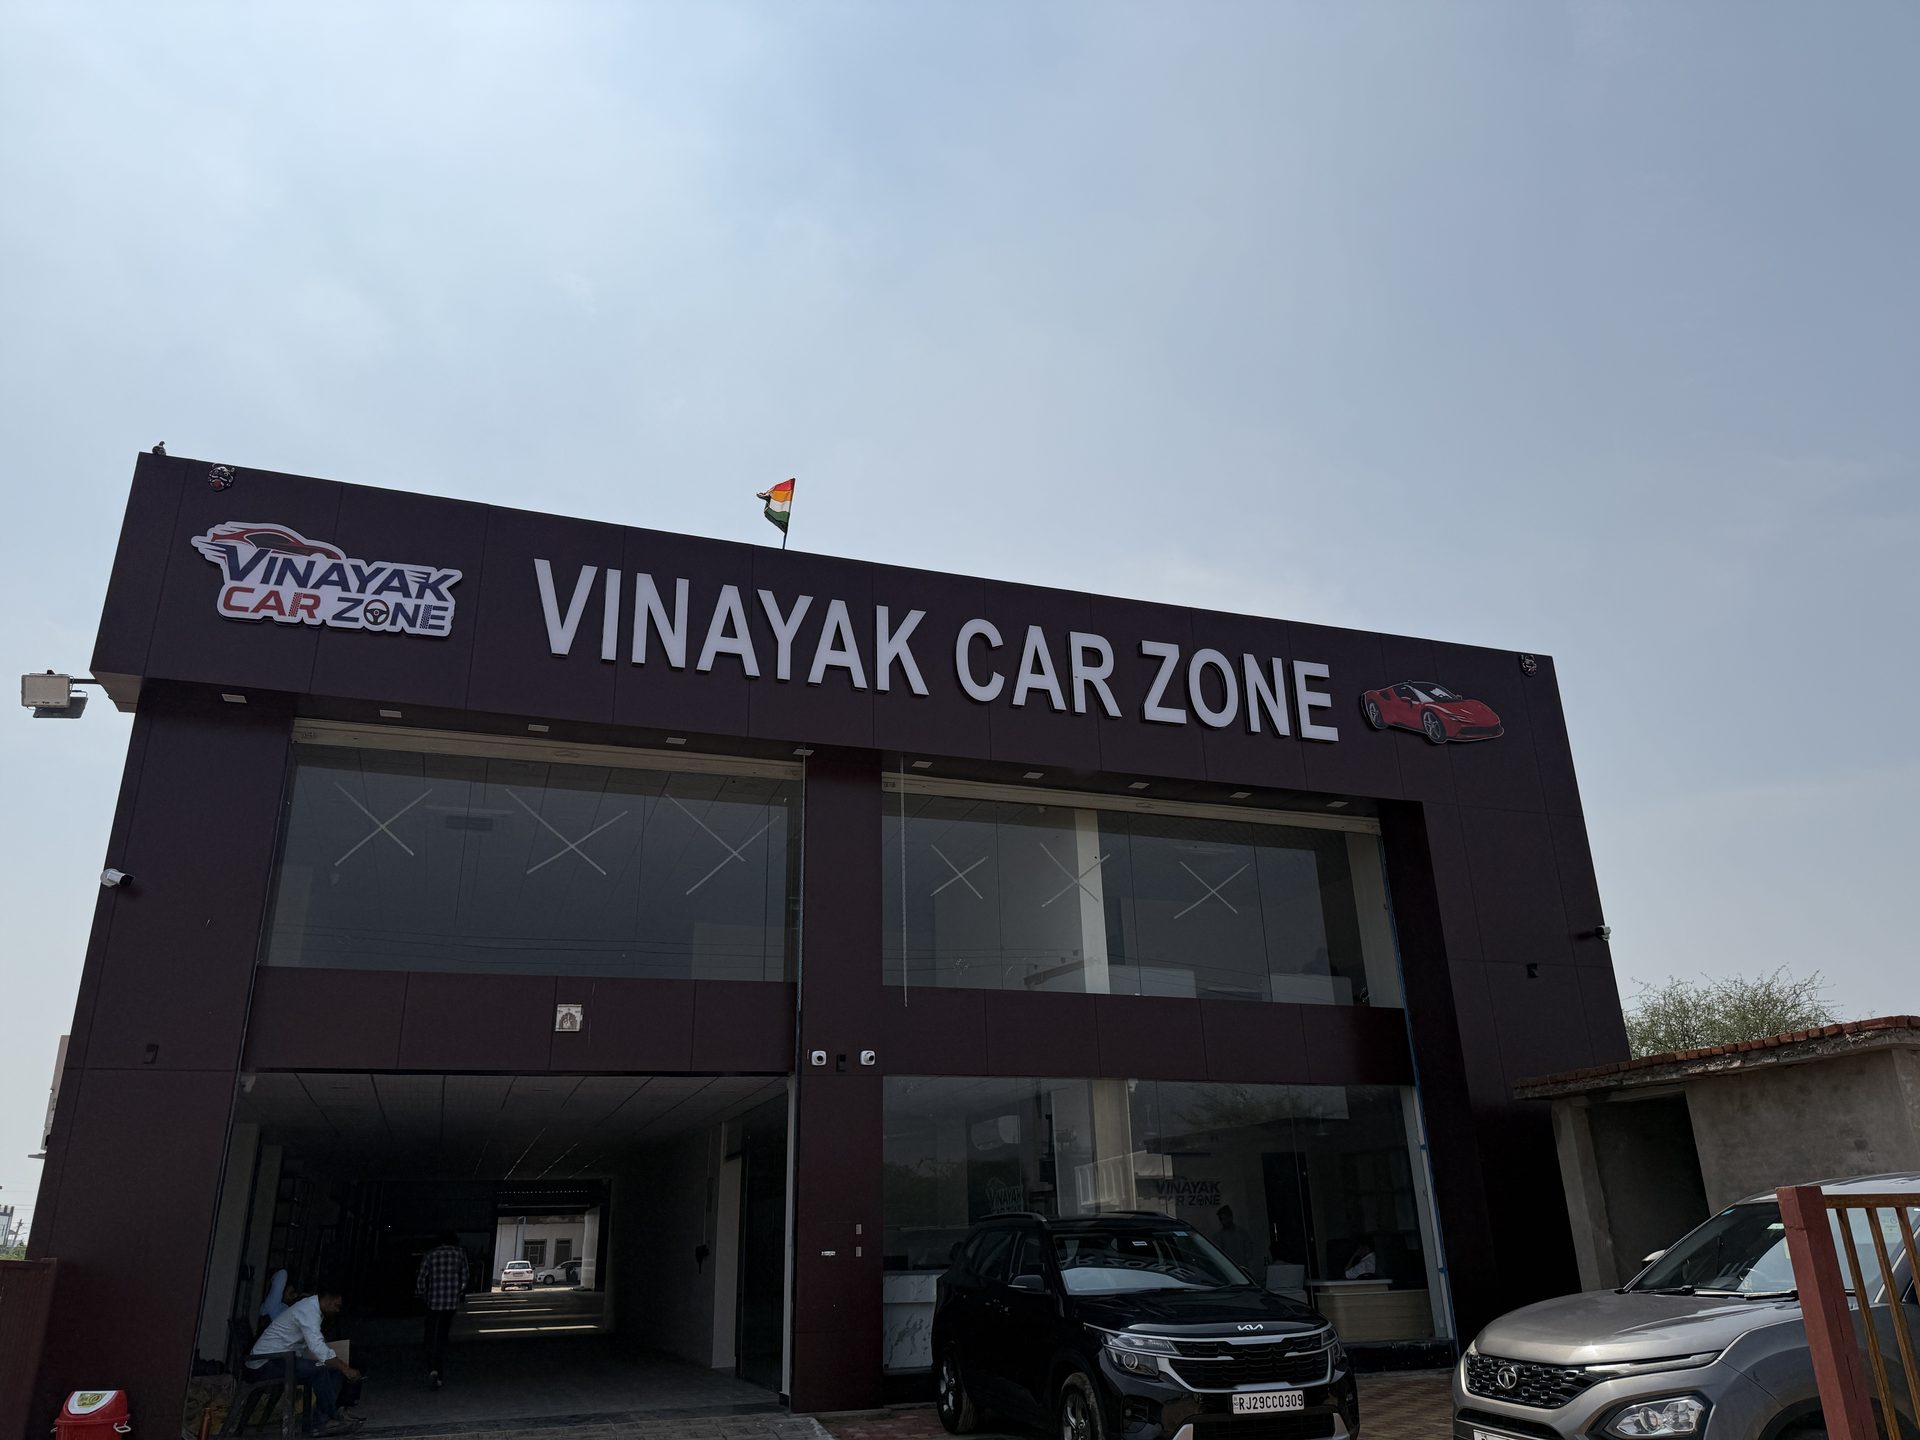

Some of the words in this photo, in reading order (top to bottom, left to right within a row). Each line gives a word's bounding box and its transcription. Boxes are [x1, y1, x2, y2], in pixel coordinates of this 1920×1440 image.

[219, 544, 456, 602] VINAYAK
[223, 586, 321, 619] CAR
[534, 558, 930, 696] VINAYAK
[956, 618, 1122, 719] CAR
[1140, 640, 1341, 743] ZONE
[1156, 1180, 1221, 1194] VINAYAK
[1239, 1394, 1303, 1410] RJ29CC0309
